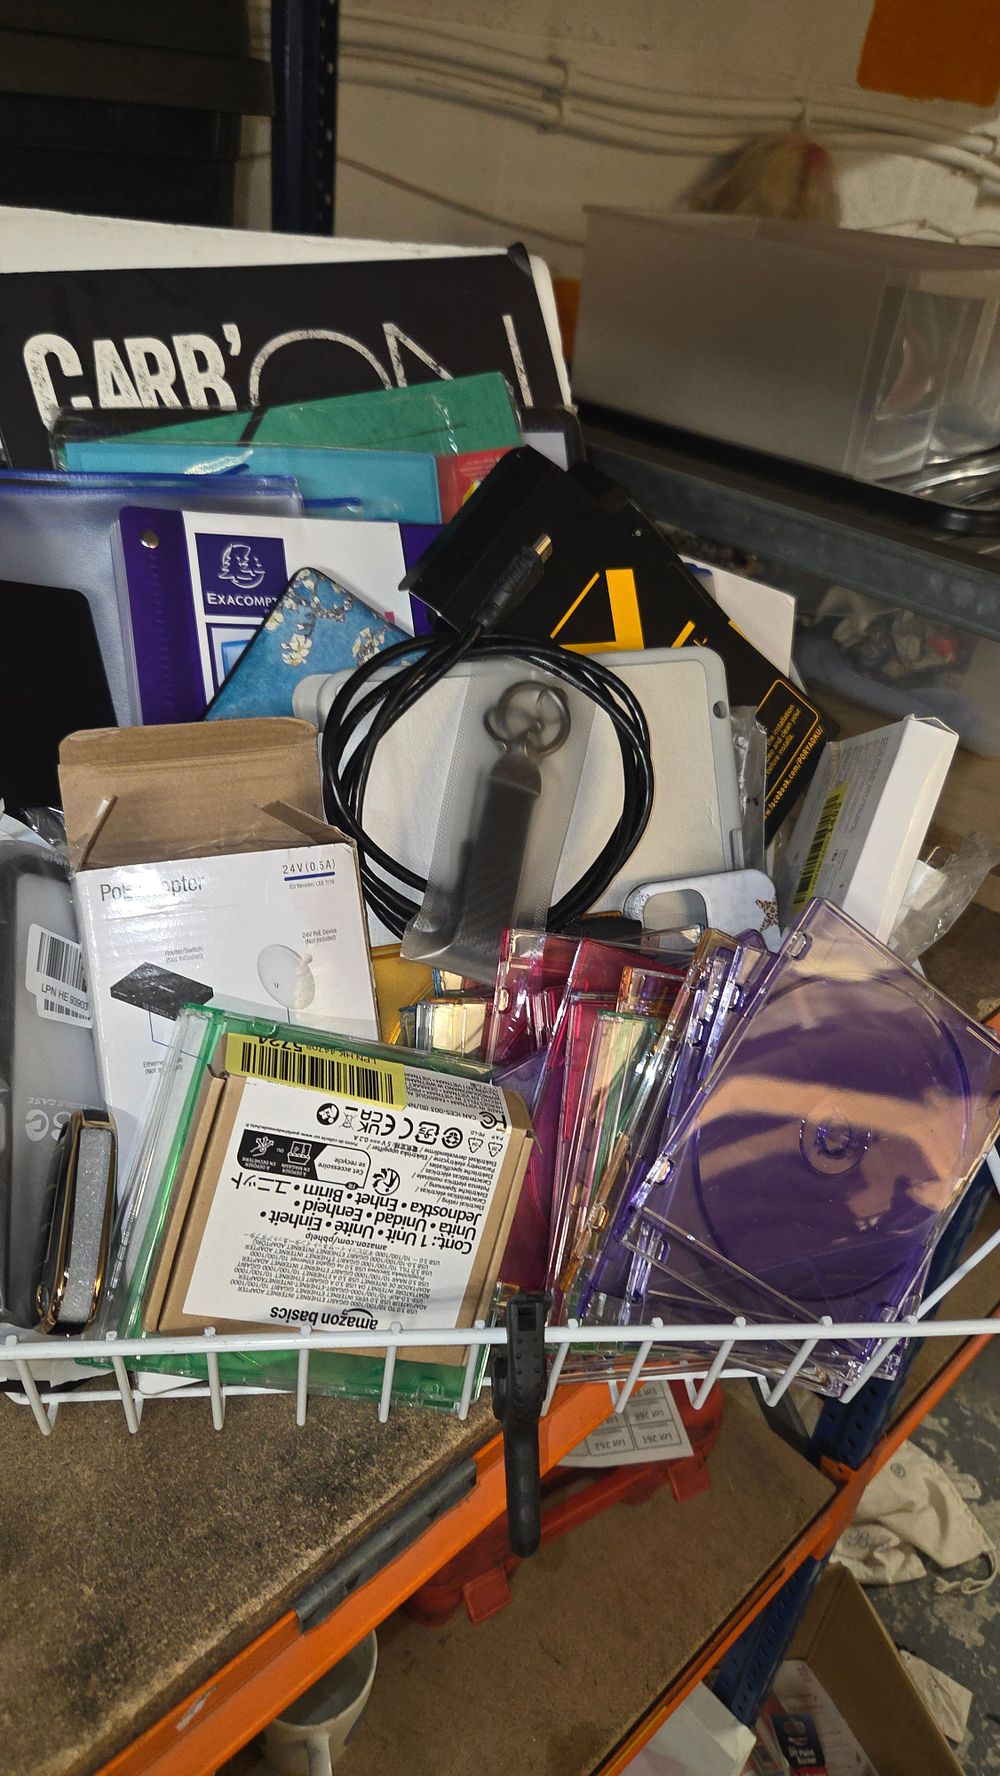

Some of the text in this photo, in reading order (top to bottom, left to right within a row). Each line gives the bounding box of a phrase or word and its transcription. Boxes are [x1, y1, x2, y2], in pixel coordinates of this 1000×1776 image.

[41, 983, 57, 998] LPN
[59, 990, 69, 1003] HE
[359, 1108, 383, 1123] CA
[462, 1112, 476, 1120] CAN
[356, 1120, 380, 1135] UK
[333, 1156, 357, 1166] recycle
[317, 1162, 351, 1173] accessoire
[228, 1170, 291, 1197] ユニット
[301, 1183, 482, 1226] Jednostka Enhet Birim
[266, 1209, 322, 1232] Einheit
[301, 1199, 477, 1241] Unità Unidad Eenheid
[332, 1220, 375, 1240] Unité
[304, 1231, 387, 1251] amazon.com/pbhelp
[383, 1228, 418, 1246] Unit
[419, 1234, 429, 1248] 1
[430, 1236, 473, 1255] Cont.:
[274, 1248, 303, 1256] INTERNET
[304, 1252, 335, 1261] ETHERNET
[241, 1255, 269, 1264] ADAPTER
[270, 1259, 299, 1268] INTERNET
[300, 1264, 329, 1272] ETHERNET
[274, 1272, 304, 1281] ETHERNET
[301, 1270, 331, 1279] ETHERNET
[236, 1286, 264, 1294] ADAPTER
[266, 1289, 294, 1298] INTERNET
[294, 1287, 325, 1296] ETHERNET
[295, 1293, 325, 1302] ETHERNET
[268, 1305, 378, 1331] amazon basics
